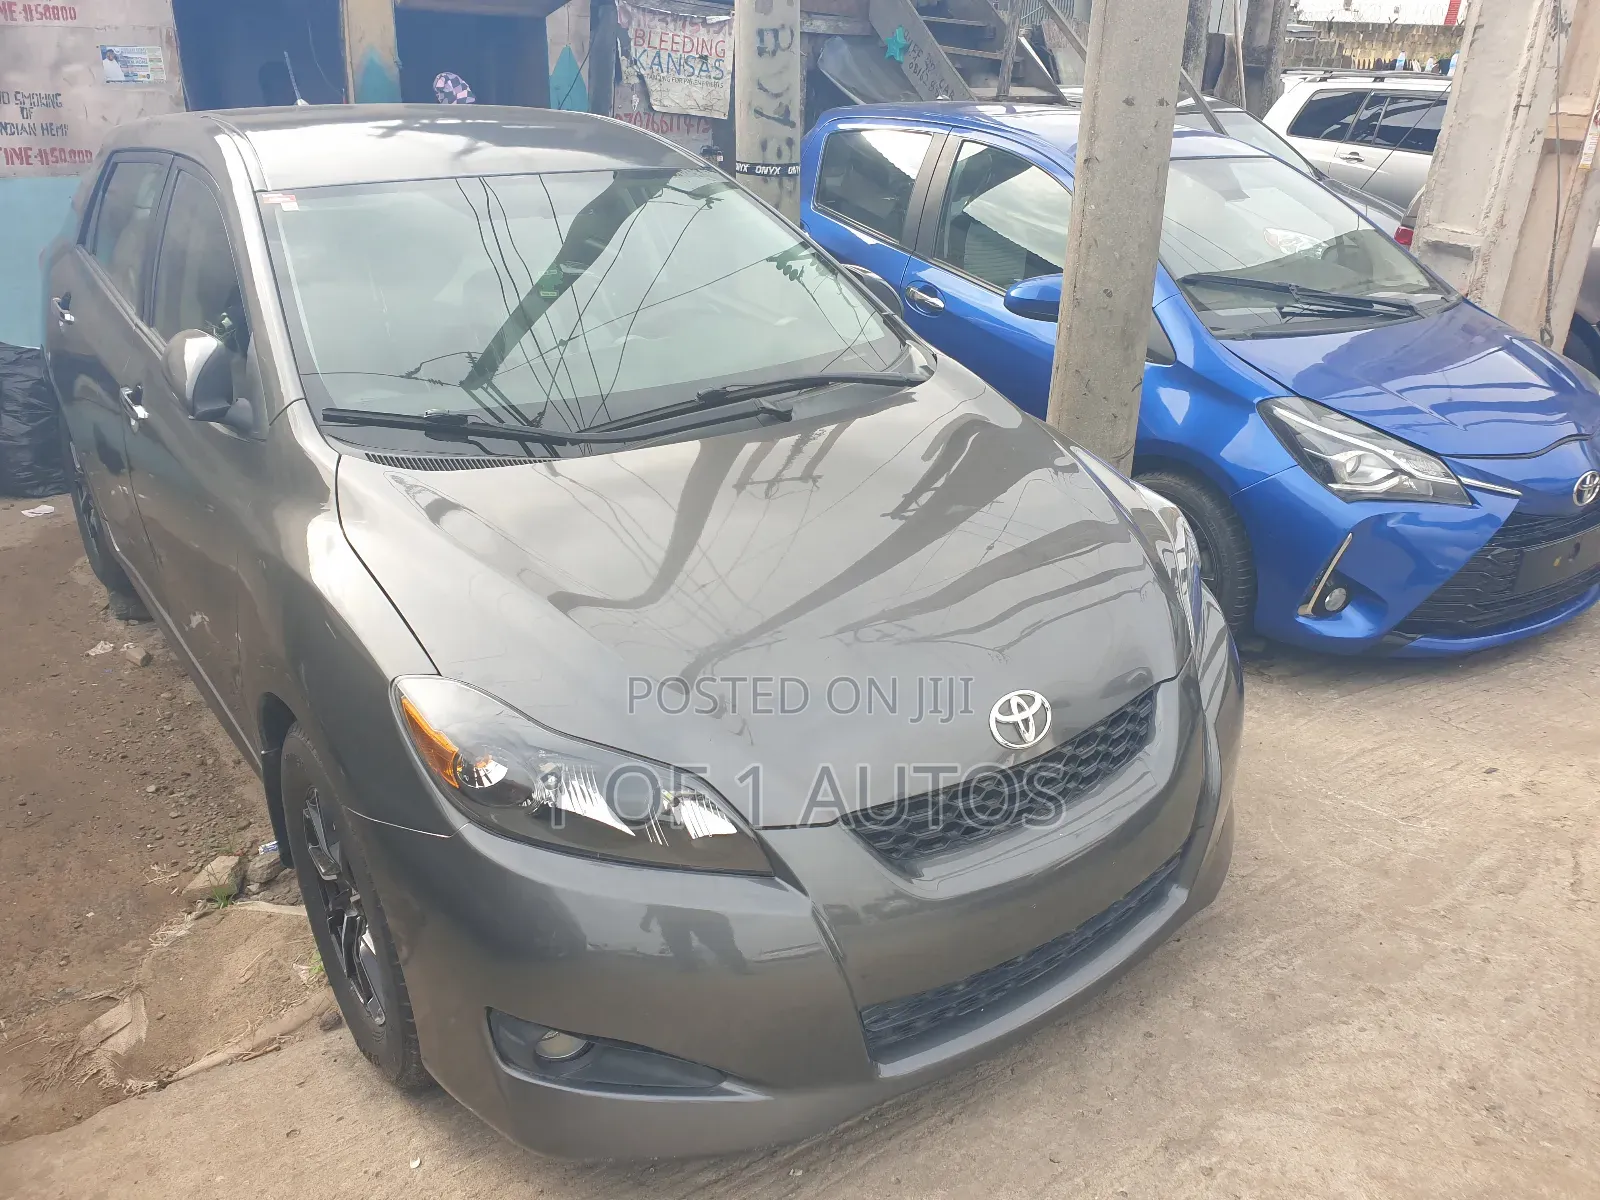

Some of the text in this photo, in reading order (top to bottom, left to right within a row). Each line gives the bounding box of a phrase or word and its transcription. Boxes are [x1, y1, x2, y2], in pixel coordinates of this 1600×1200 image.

[633, 28, 726, 58] BLEEDING
[633, 49, 725, 81] KANSAS
[14, 91, 64, 109] SMOKING
[20, 106, 34, 120] OF
[755, 165, 781, 175] ONYX
